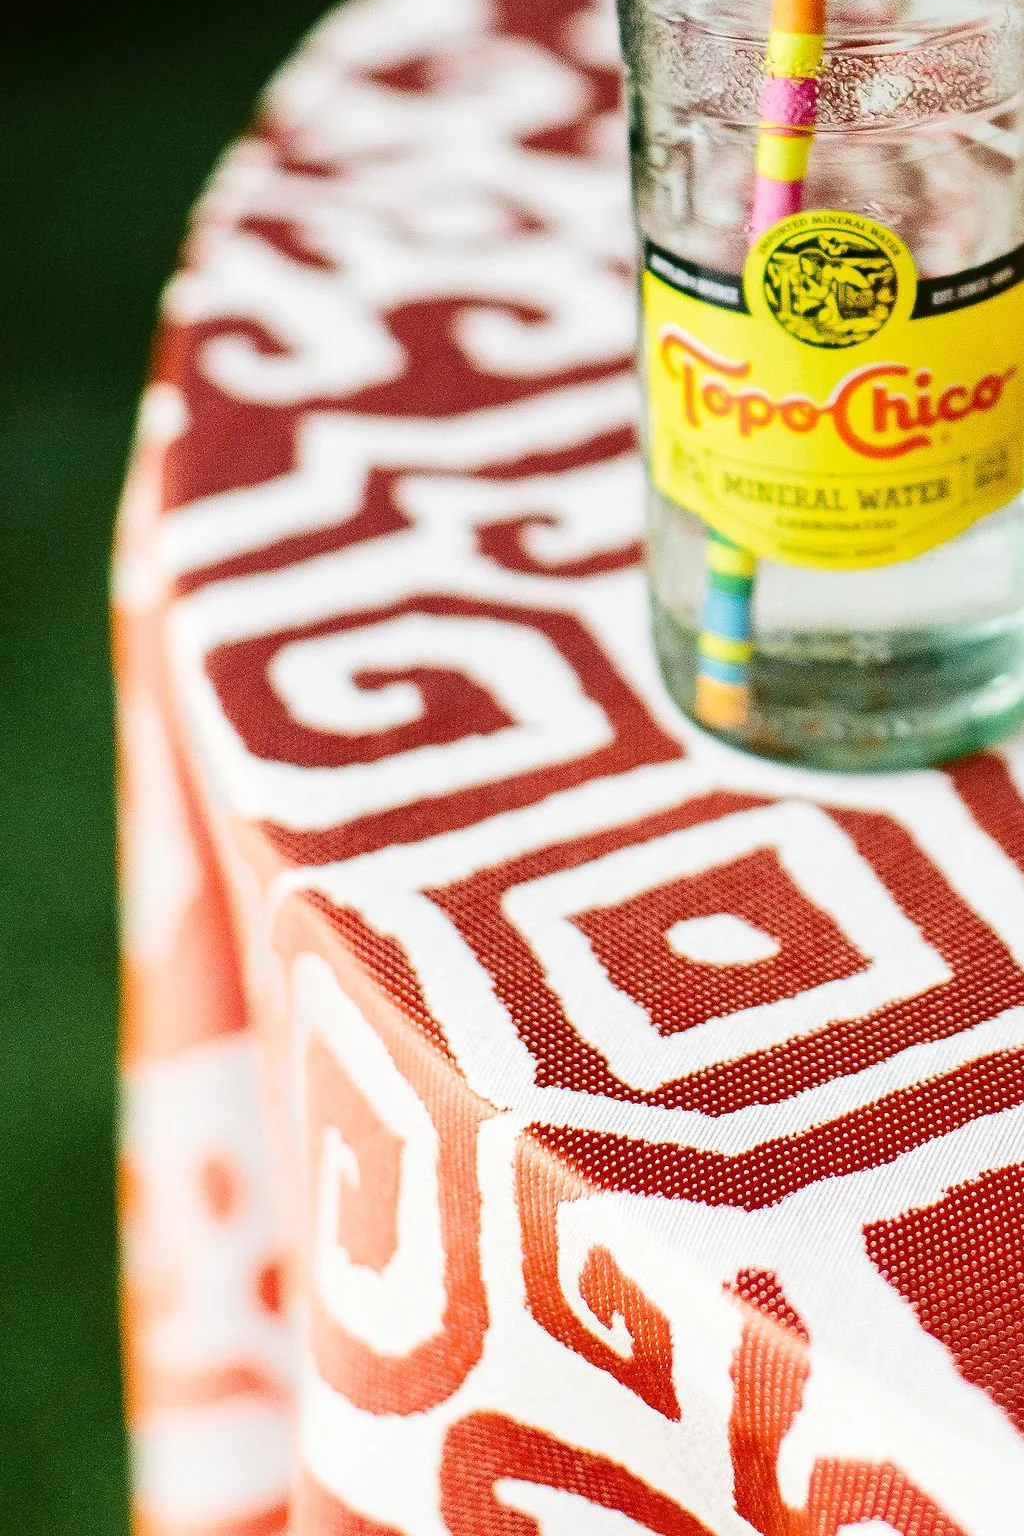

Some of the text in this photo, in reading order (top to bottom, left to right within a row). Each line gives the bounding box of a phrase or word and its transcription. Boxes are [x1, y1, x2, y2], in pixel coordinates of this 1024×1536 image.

[812, 216, 865, 231] MINERAL
[659, 322, 1016, 460] Topo Chico
[723, 471, 950, 512] MINERAL WATER
